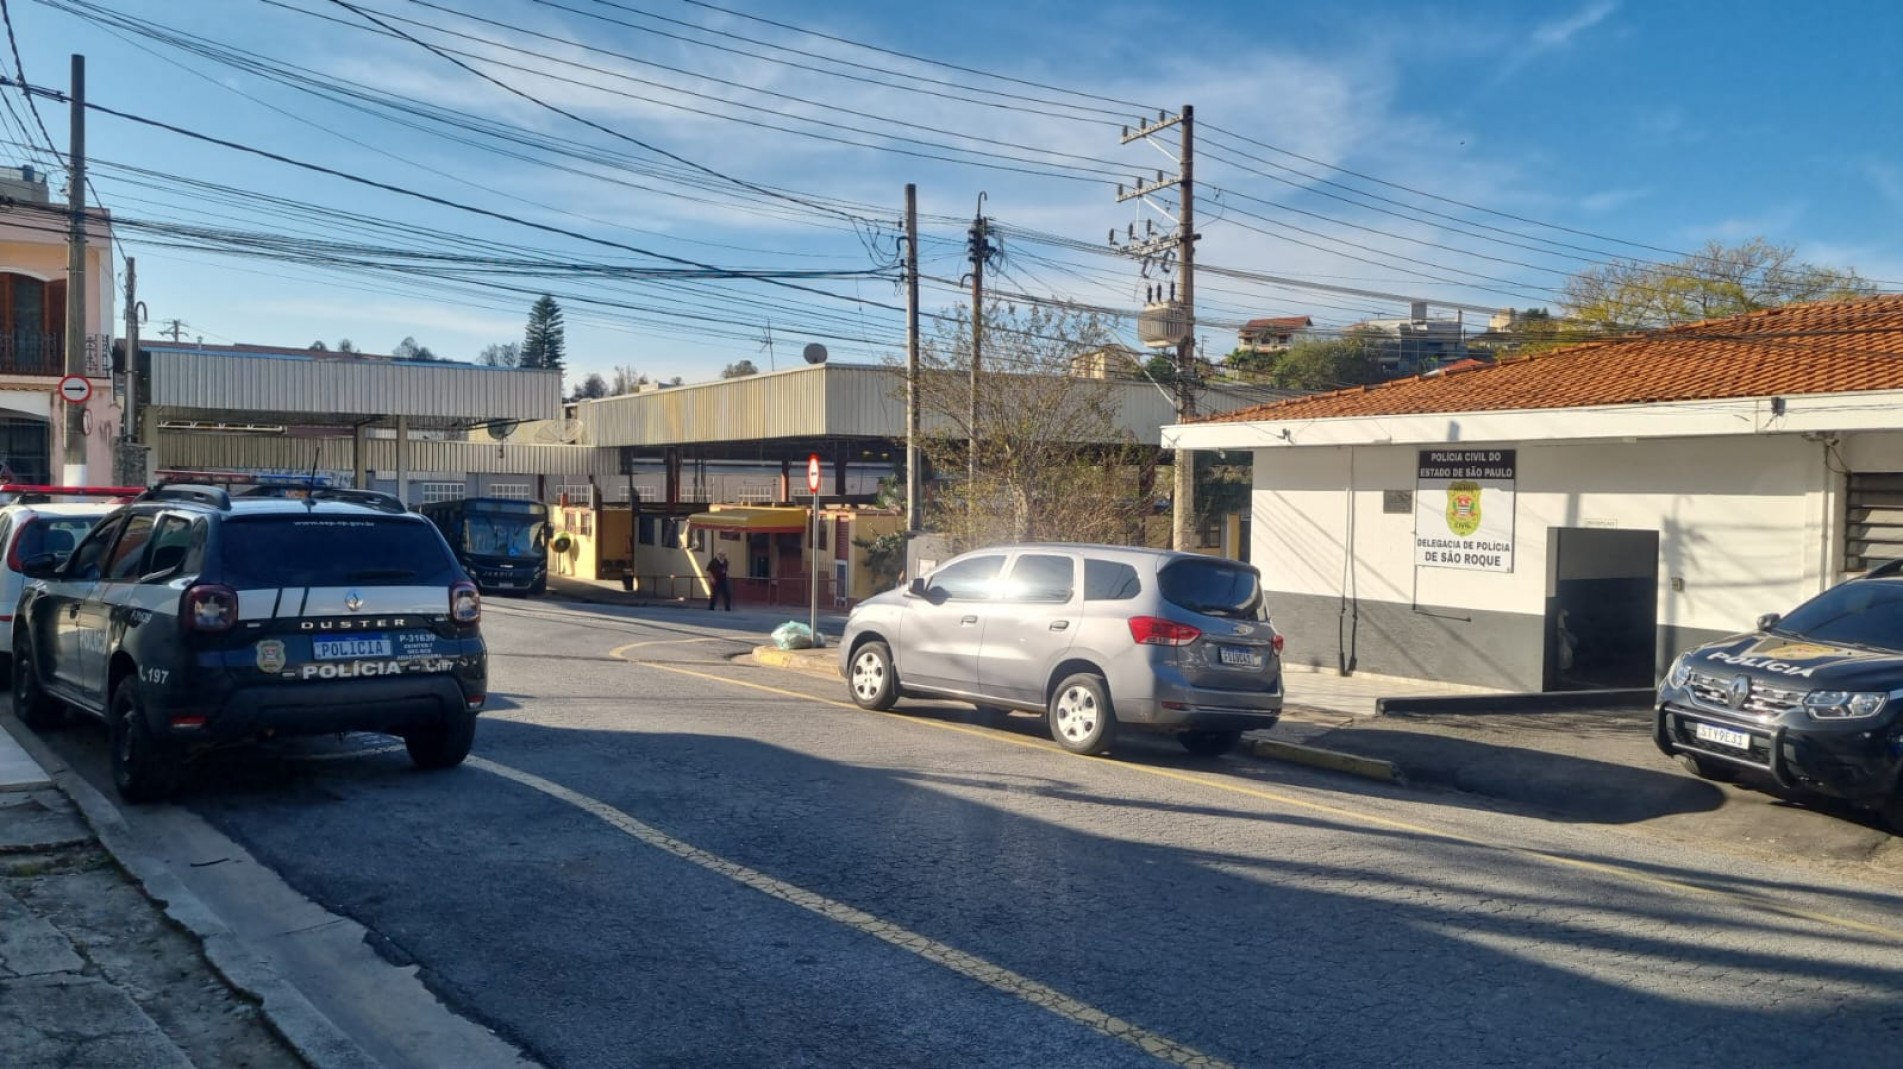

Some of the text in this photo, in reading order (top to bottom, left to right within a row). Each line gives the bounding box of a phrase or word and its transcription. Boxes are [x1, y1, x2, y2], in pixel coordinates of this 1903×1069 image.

[1431, 452, 1501, 461] POLÍCIA CIVIL DO
[1420, 466, 1513, 477] ESTADO DE SÃO PAULO
[1417, 538, 1510, 552] DELEGACIA DE POLÍCIA
[1425, 550, 1501, 567] DE SÃO ROQUE
[301, 619, 405, 629] DUSTER
[302, 660, 402, 679] POLÍCIA
[1707, 652, 1816, 677] POLÍCIA
[148, 667, 169, 684] 197
